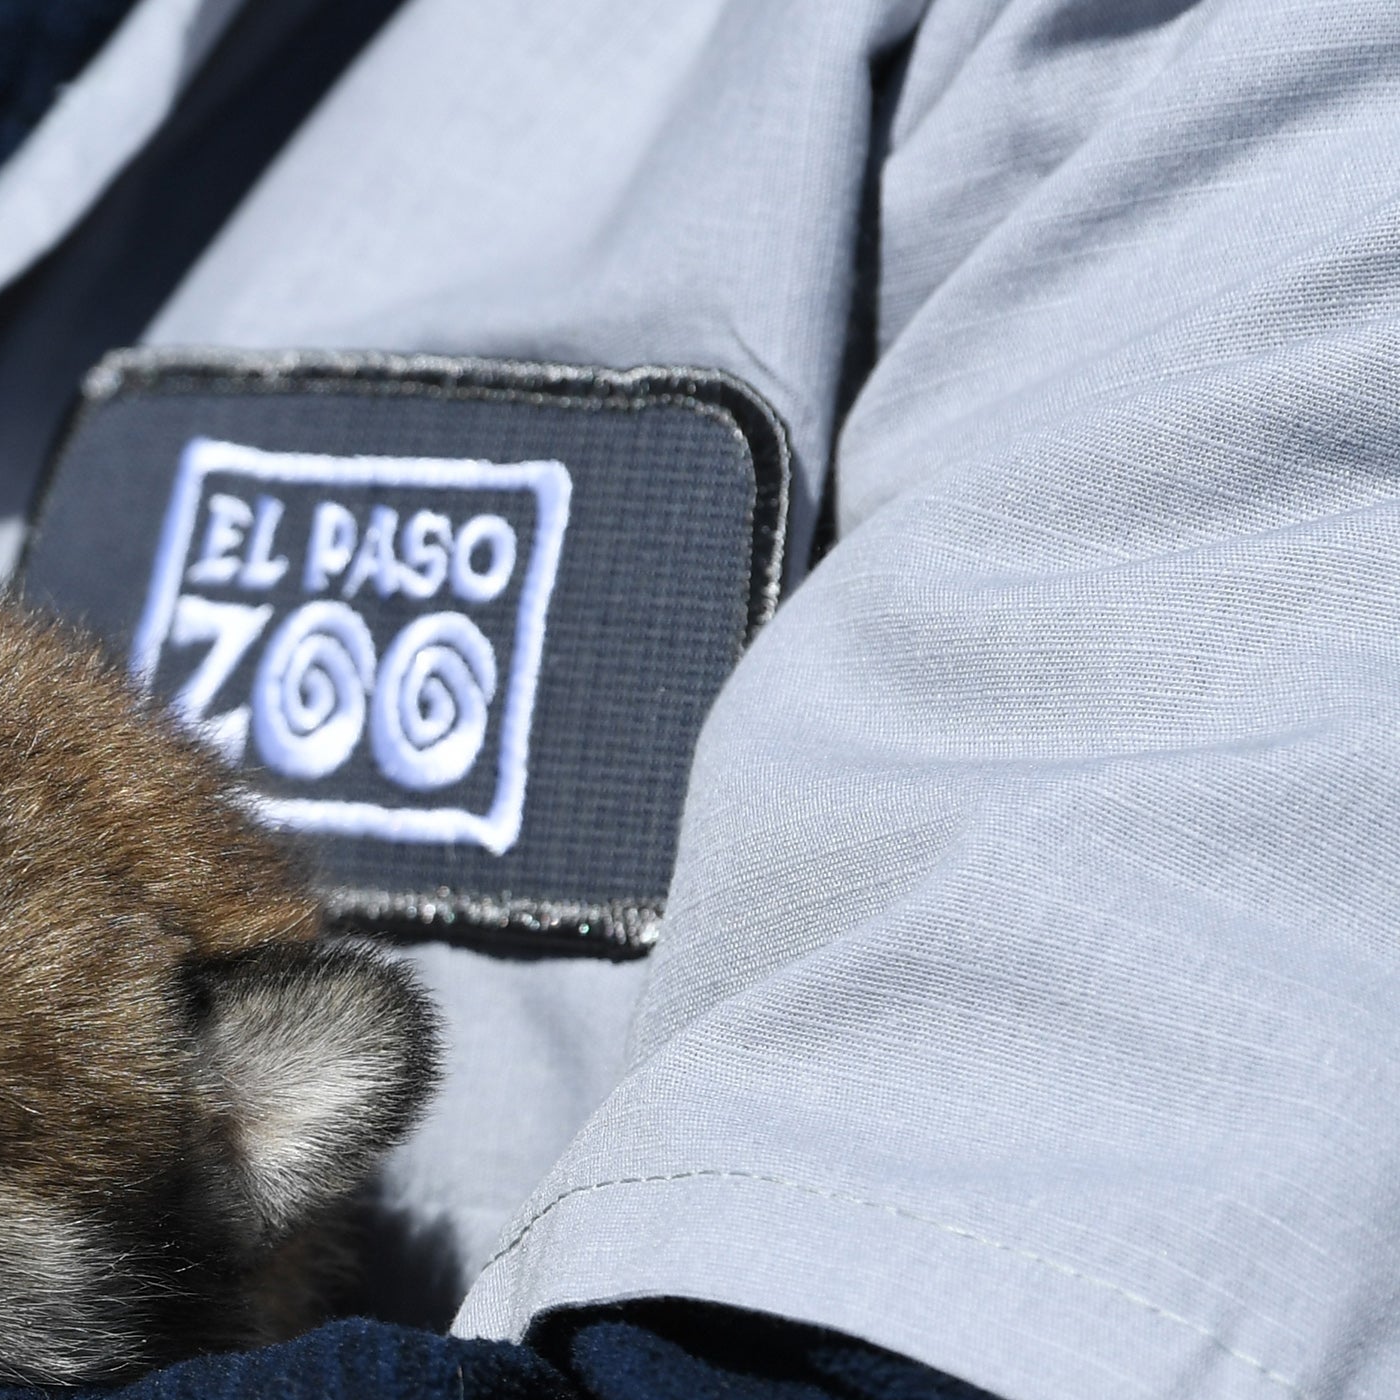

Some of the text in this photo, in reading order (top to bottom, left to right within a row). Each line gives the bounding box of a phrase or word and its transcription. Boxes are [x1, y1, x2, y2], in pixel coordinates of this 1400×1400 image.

[188, 494, 517, 602] EL PASO
[168, 595, 497, 790] ZOO
